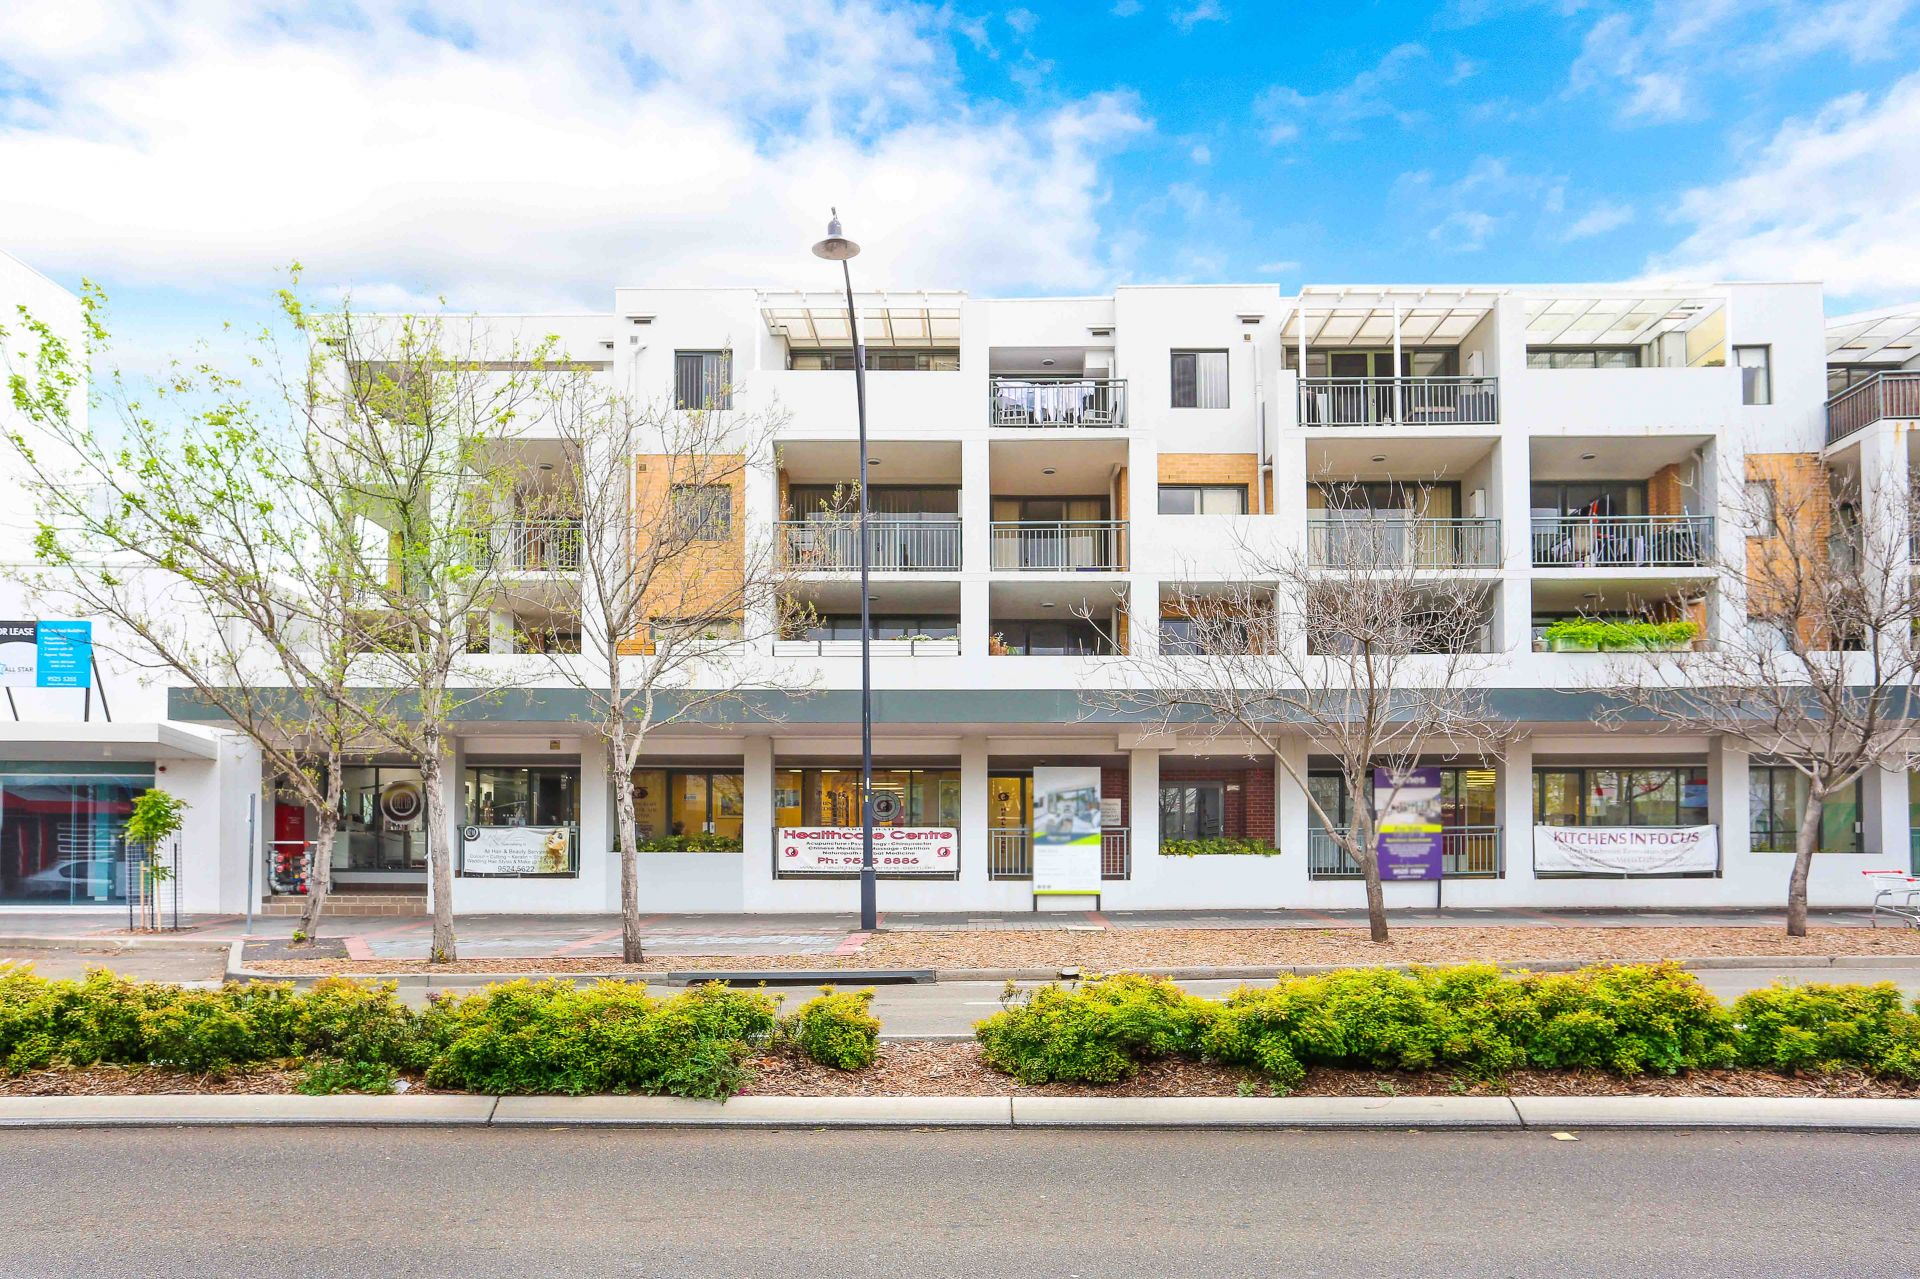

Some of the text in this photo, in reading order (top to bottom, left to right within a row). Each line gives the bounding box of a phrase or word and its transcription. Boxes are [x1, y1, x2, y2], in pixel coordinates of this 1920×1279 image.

[9, 627, 34, 636] LEASE
[783, 829, 953, 840] Healthcae Centre
[1554, 831, 1699, 845] KITCHENS IN FOCUS
[843, 857, 879, 865] 955
[883, 857, 920, 865] 8886
